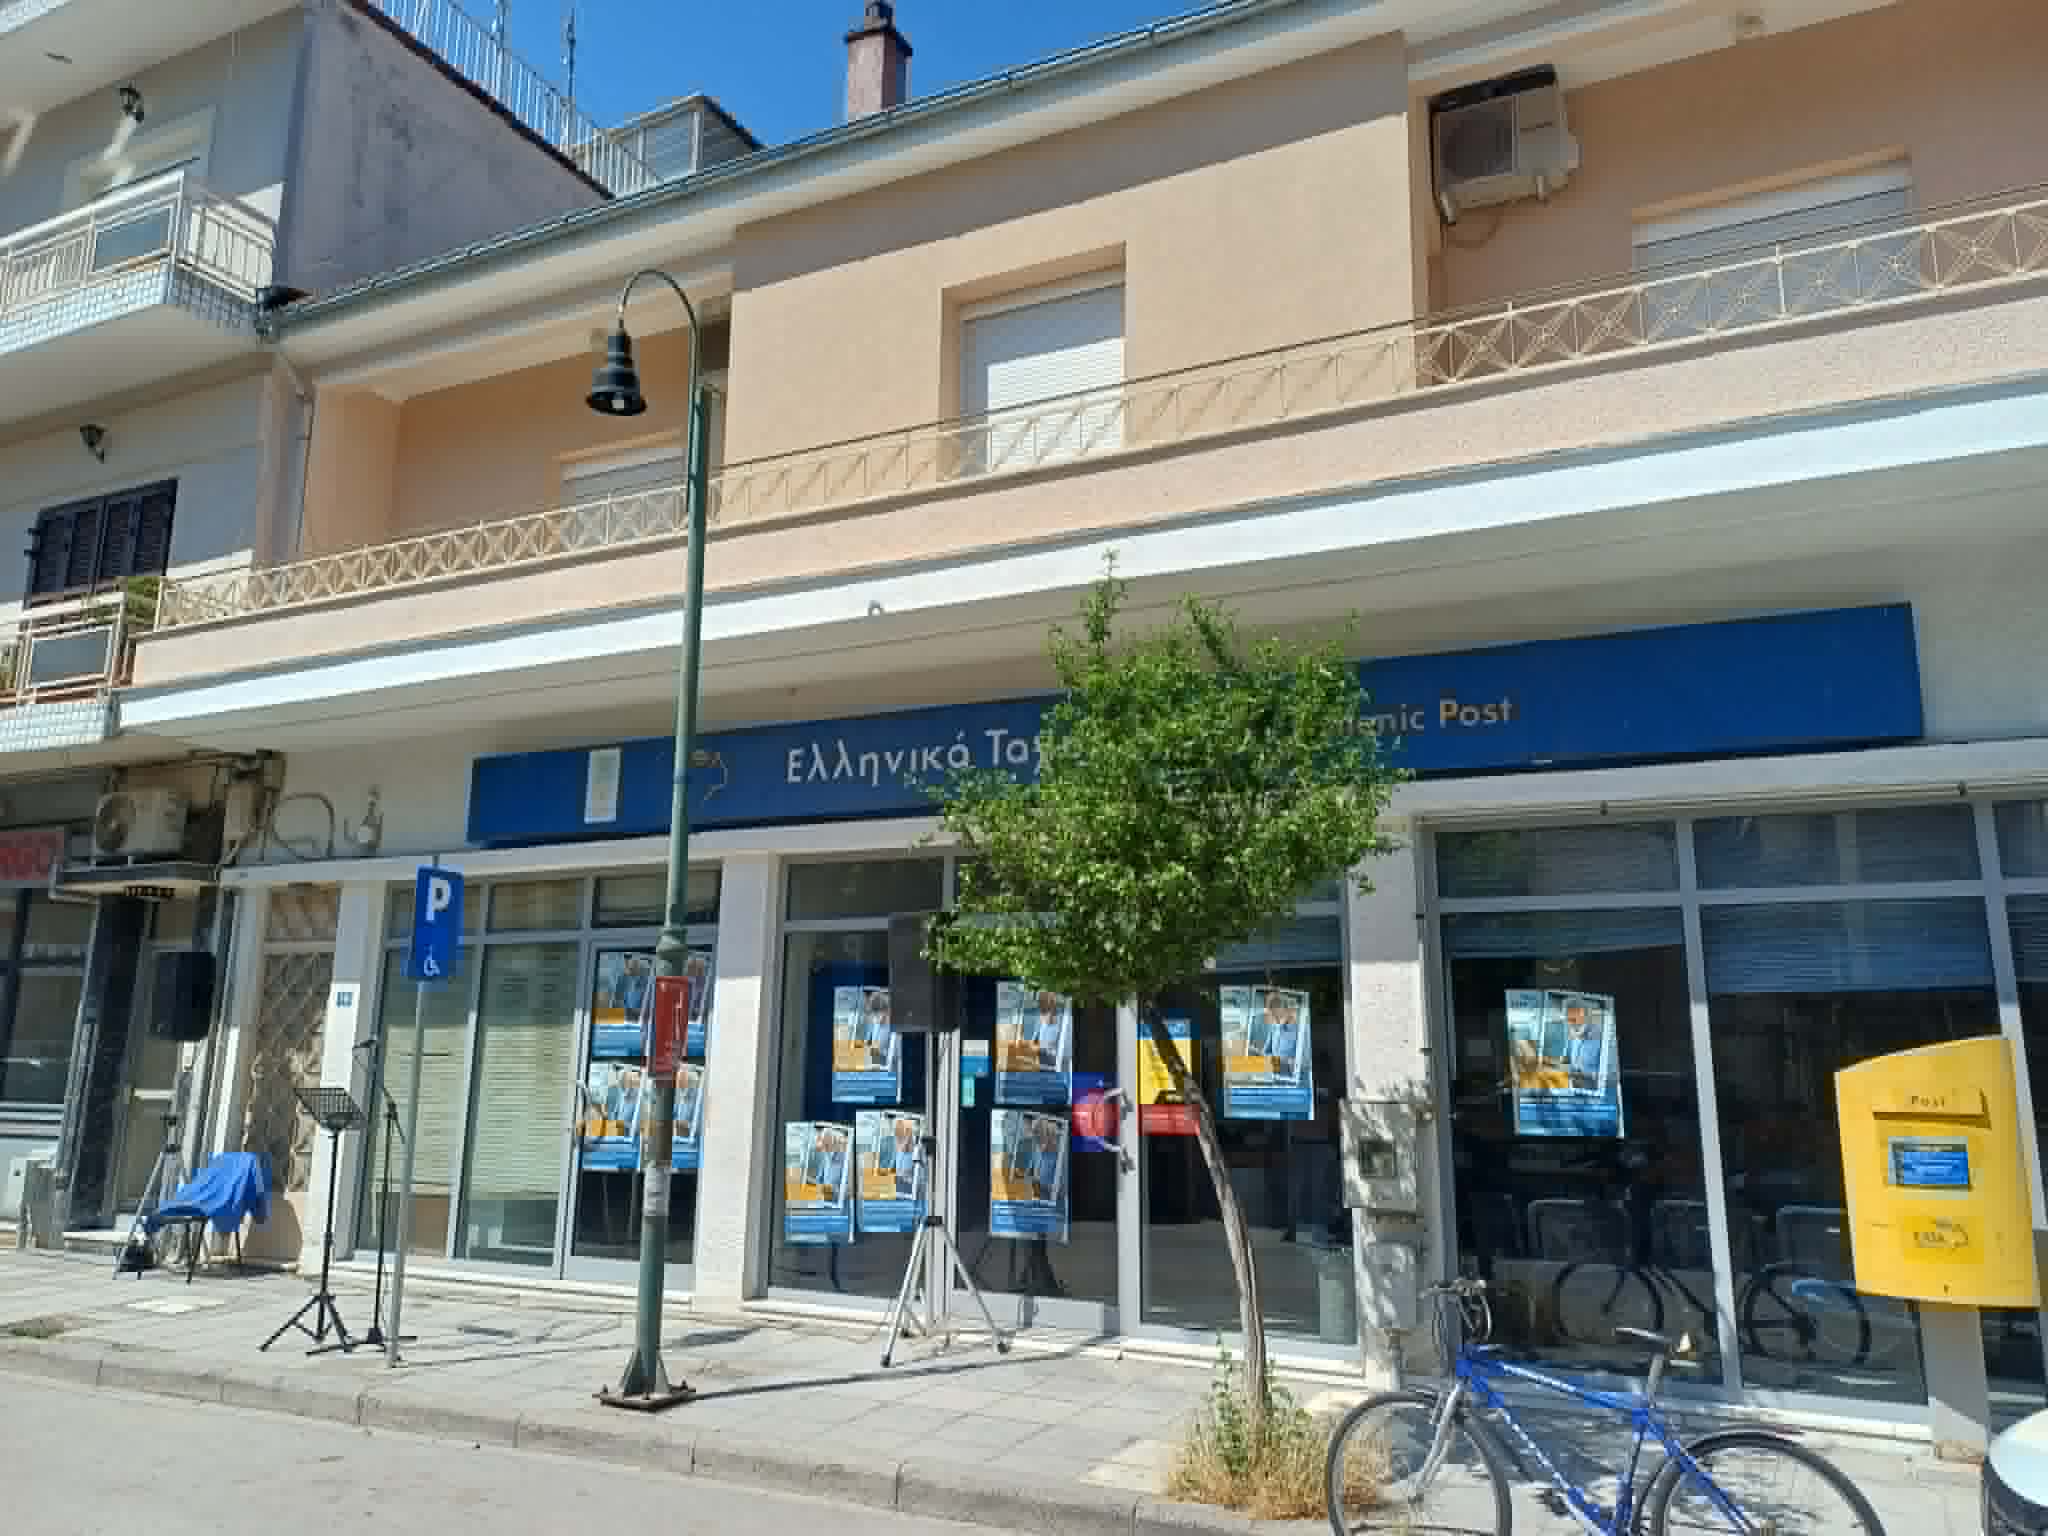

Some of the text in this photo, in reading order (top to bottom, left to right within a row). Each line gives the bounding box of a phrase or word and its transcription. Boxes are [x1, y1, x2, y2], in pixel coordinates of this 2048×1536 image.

[1440, 696, 1513, 728] Post
[784, 730, 972, 787] Ελληνικά
[426, 876, 451, 921] P
